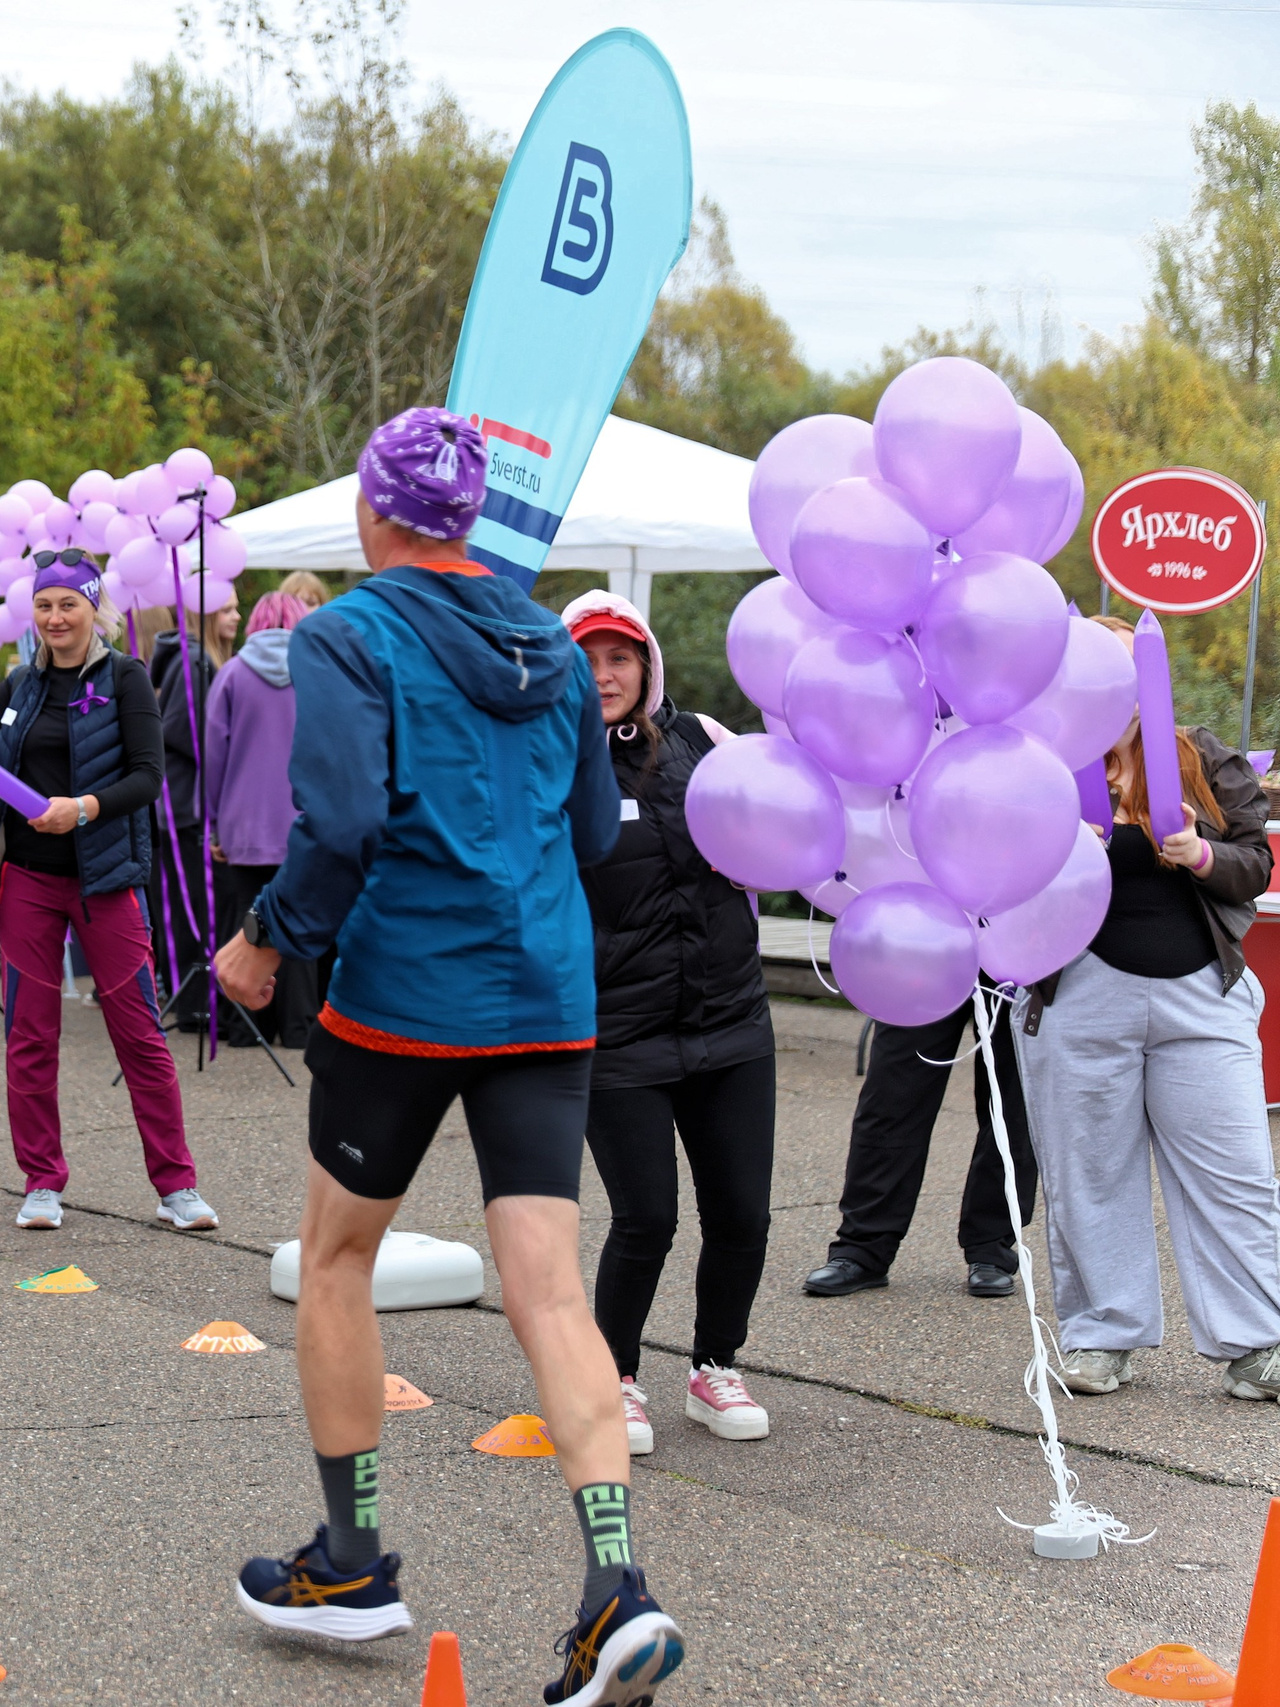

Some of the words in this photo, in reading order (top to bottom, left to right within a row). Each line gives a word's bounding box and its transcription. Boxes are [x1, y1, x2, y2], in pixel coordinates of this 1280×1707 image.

[490, 452, 541, 494] 5verst.ru
[1120, 503, 1238, 552] Ярхлеб
[1164, 561, 1191, 579] 1996
[581, 1485, 631, 1568] ELITE
